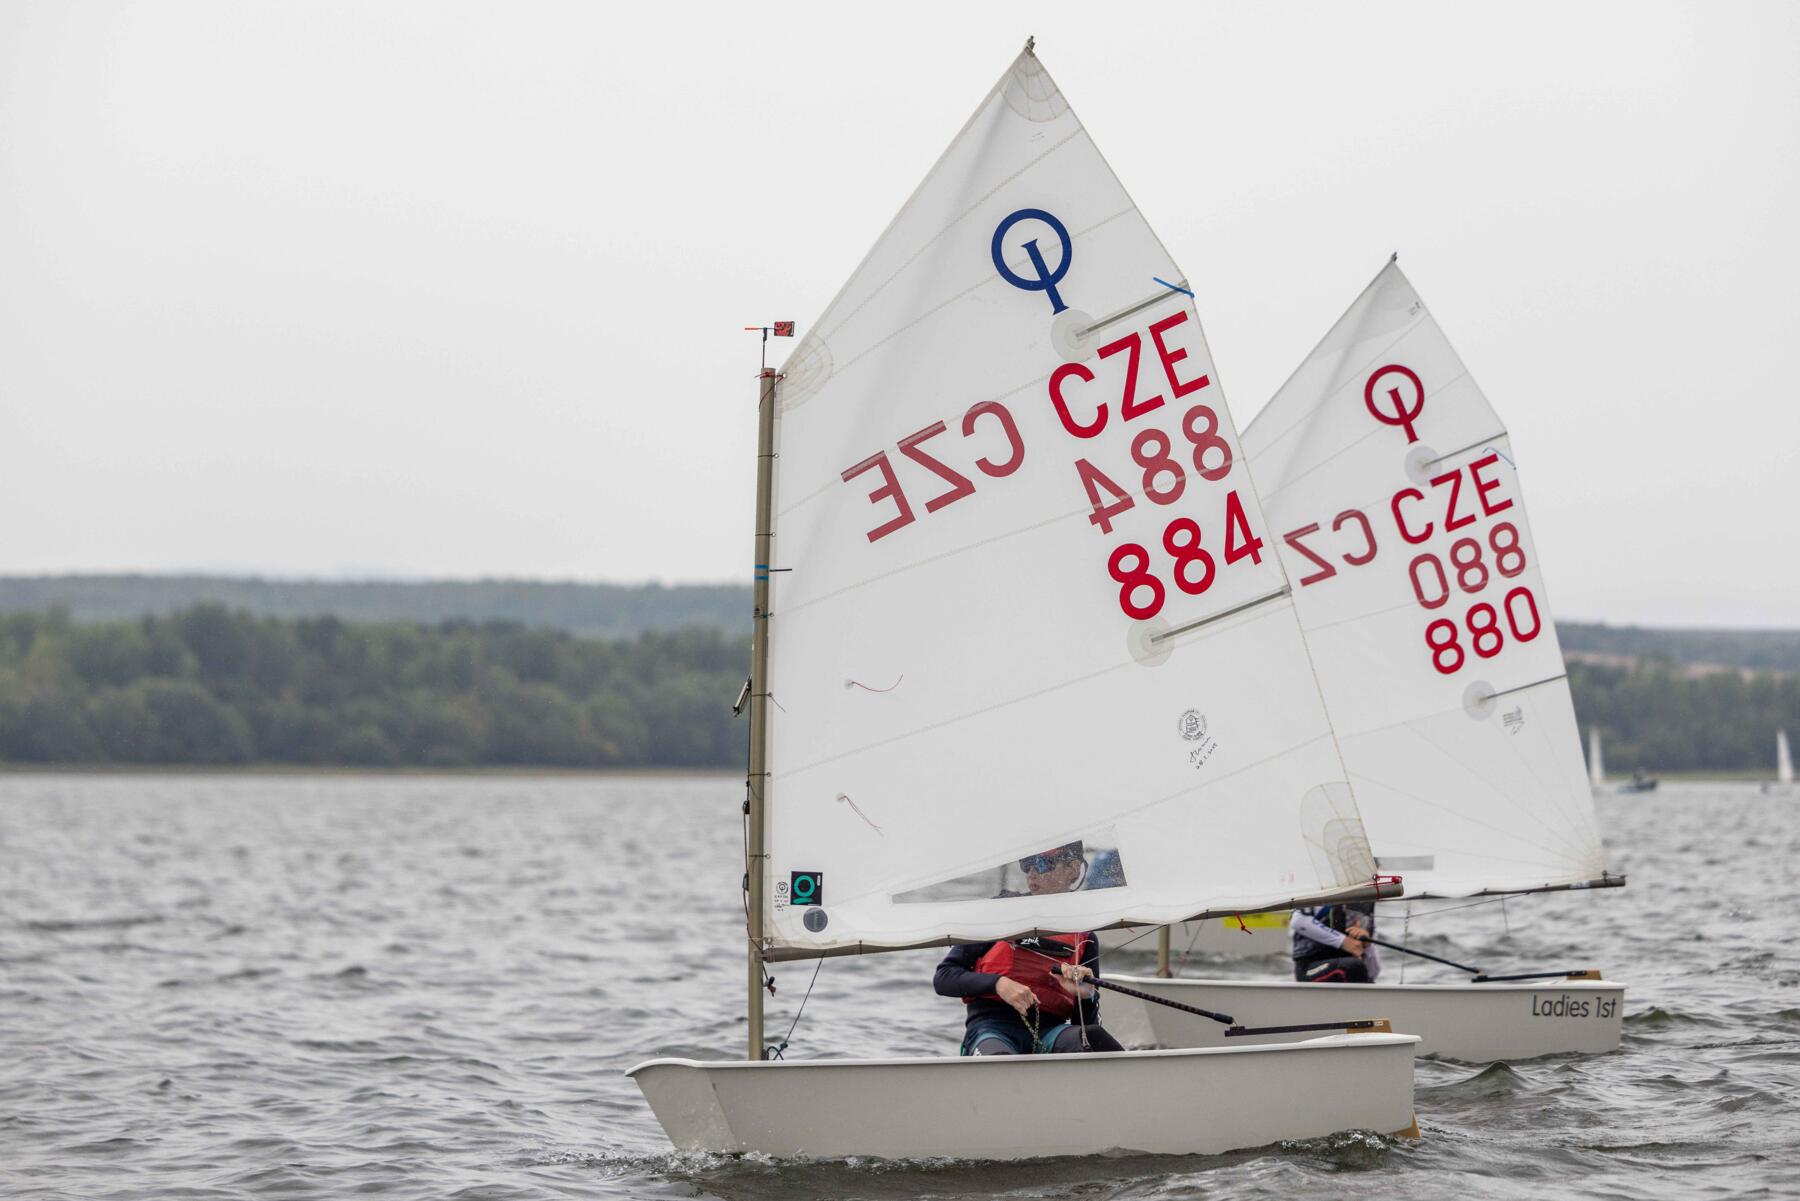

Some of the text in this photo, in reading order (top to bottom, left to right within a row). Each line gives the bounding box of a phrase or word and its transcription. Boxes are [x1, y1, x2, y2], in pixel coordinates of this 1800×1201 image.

[1048, 311, 1211, 439] CZE
[1391, 454, 1514, 545] CZE
[1107, 490, 1264, 621] 884
[1424, 586, 1542, 675] 880
[1532, 994, 1617, 1018] Ladies 1st
